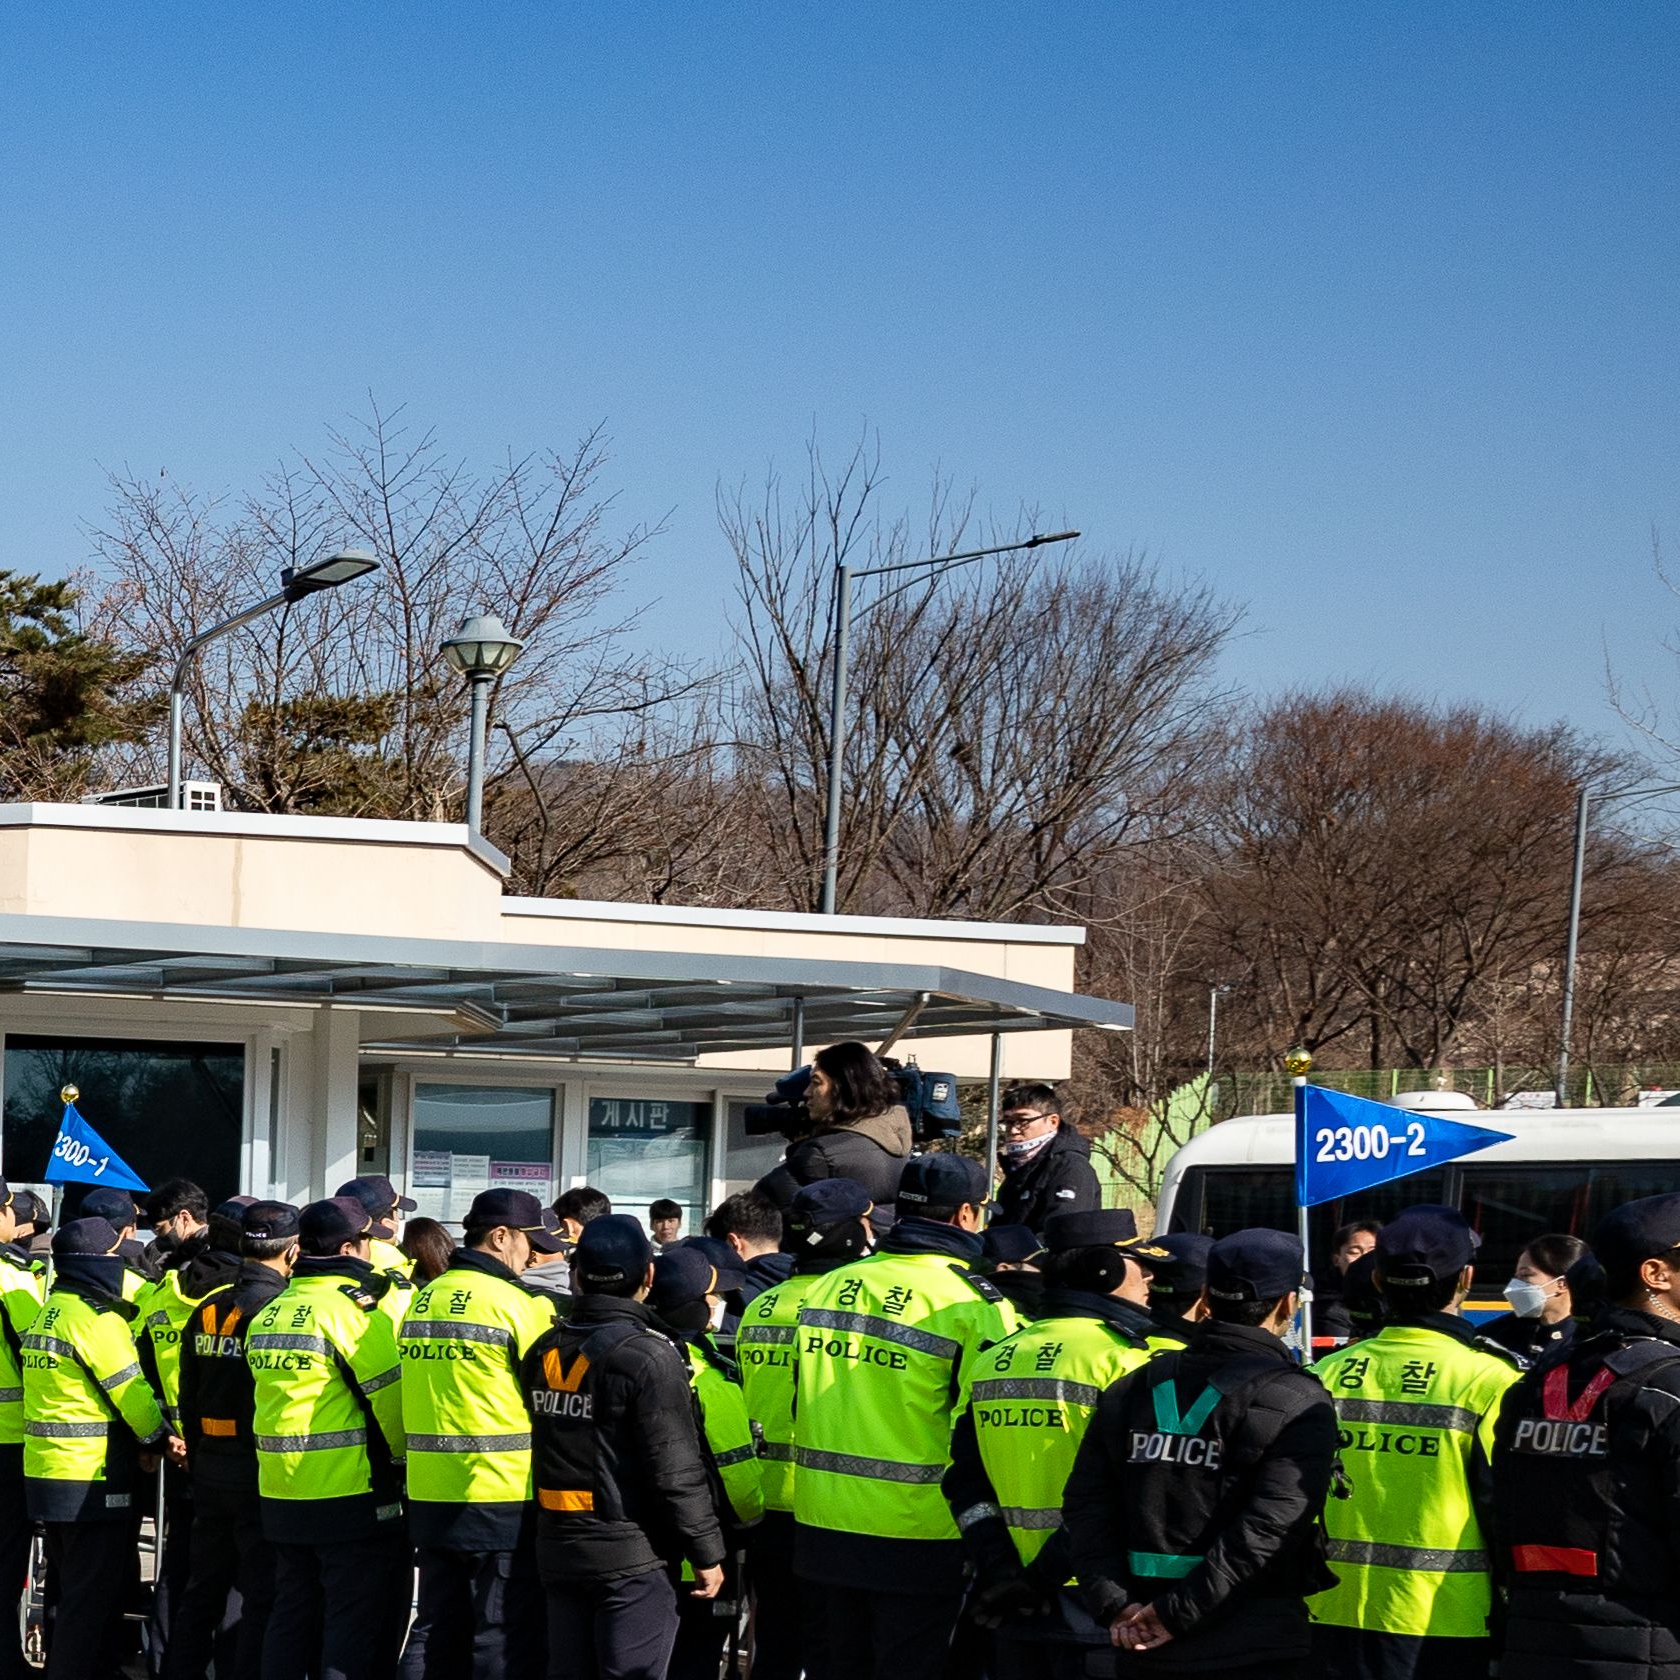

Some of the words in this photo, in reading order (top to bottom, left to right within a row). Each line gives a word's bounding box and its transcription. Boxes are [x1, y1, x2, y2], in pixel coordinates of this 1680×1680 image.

[601, 1101, 669, 1130] 게시판
[1316, 1122, 1426, 1163] 2300-2
[195, 1334, 241, 1356] POLICE
[399, 1344, 476, 1361] POLICE
[805, 1337, 908, 1371] POLICE
[532, 1389, 592, 1419] POLICE
[979, 1407, 1064, 1428] POLICE
[1131, 1432, 1221, 1469] POLICE
[1514, 1420, 1607, 1455] POLICE
